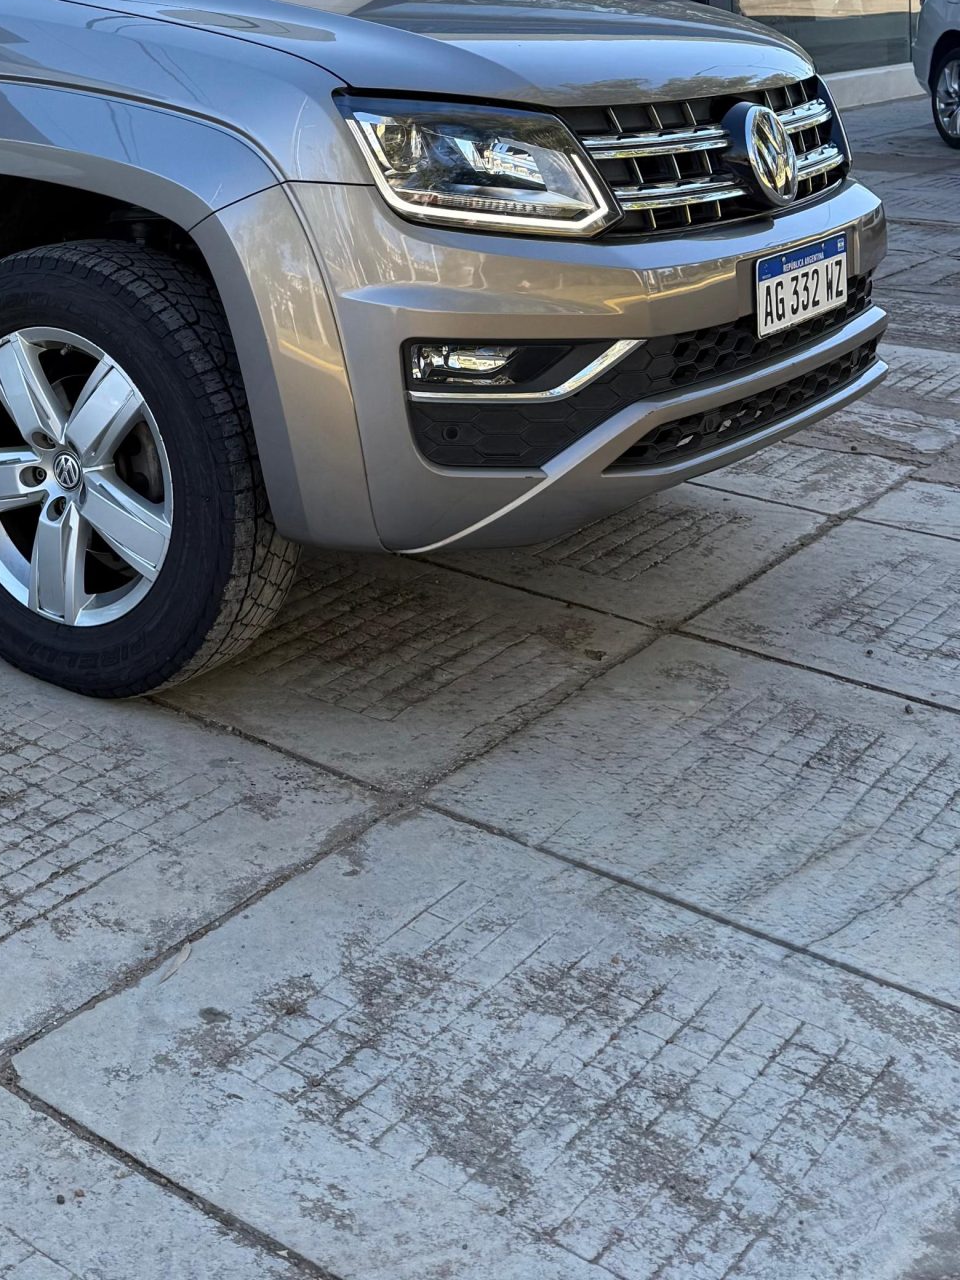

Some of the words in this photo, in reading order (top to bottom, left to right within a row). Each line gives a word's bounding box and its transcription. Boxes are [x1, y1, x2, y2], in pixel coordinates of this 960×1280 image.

[764, 280, 786, 327] AG
[790, 268, 820, 315] 332
[825, 259, 844, 301] WZ
